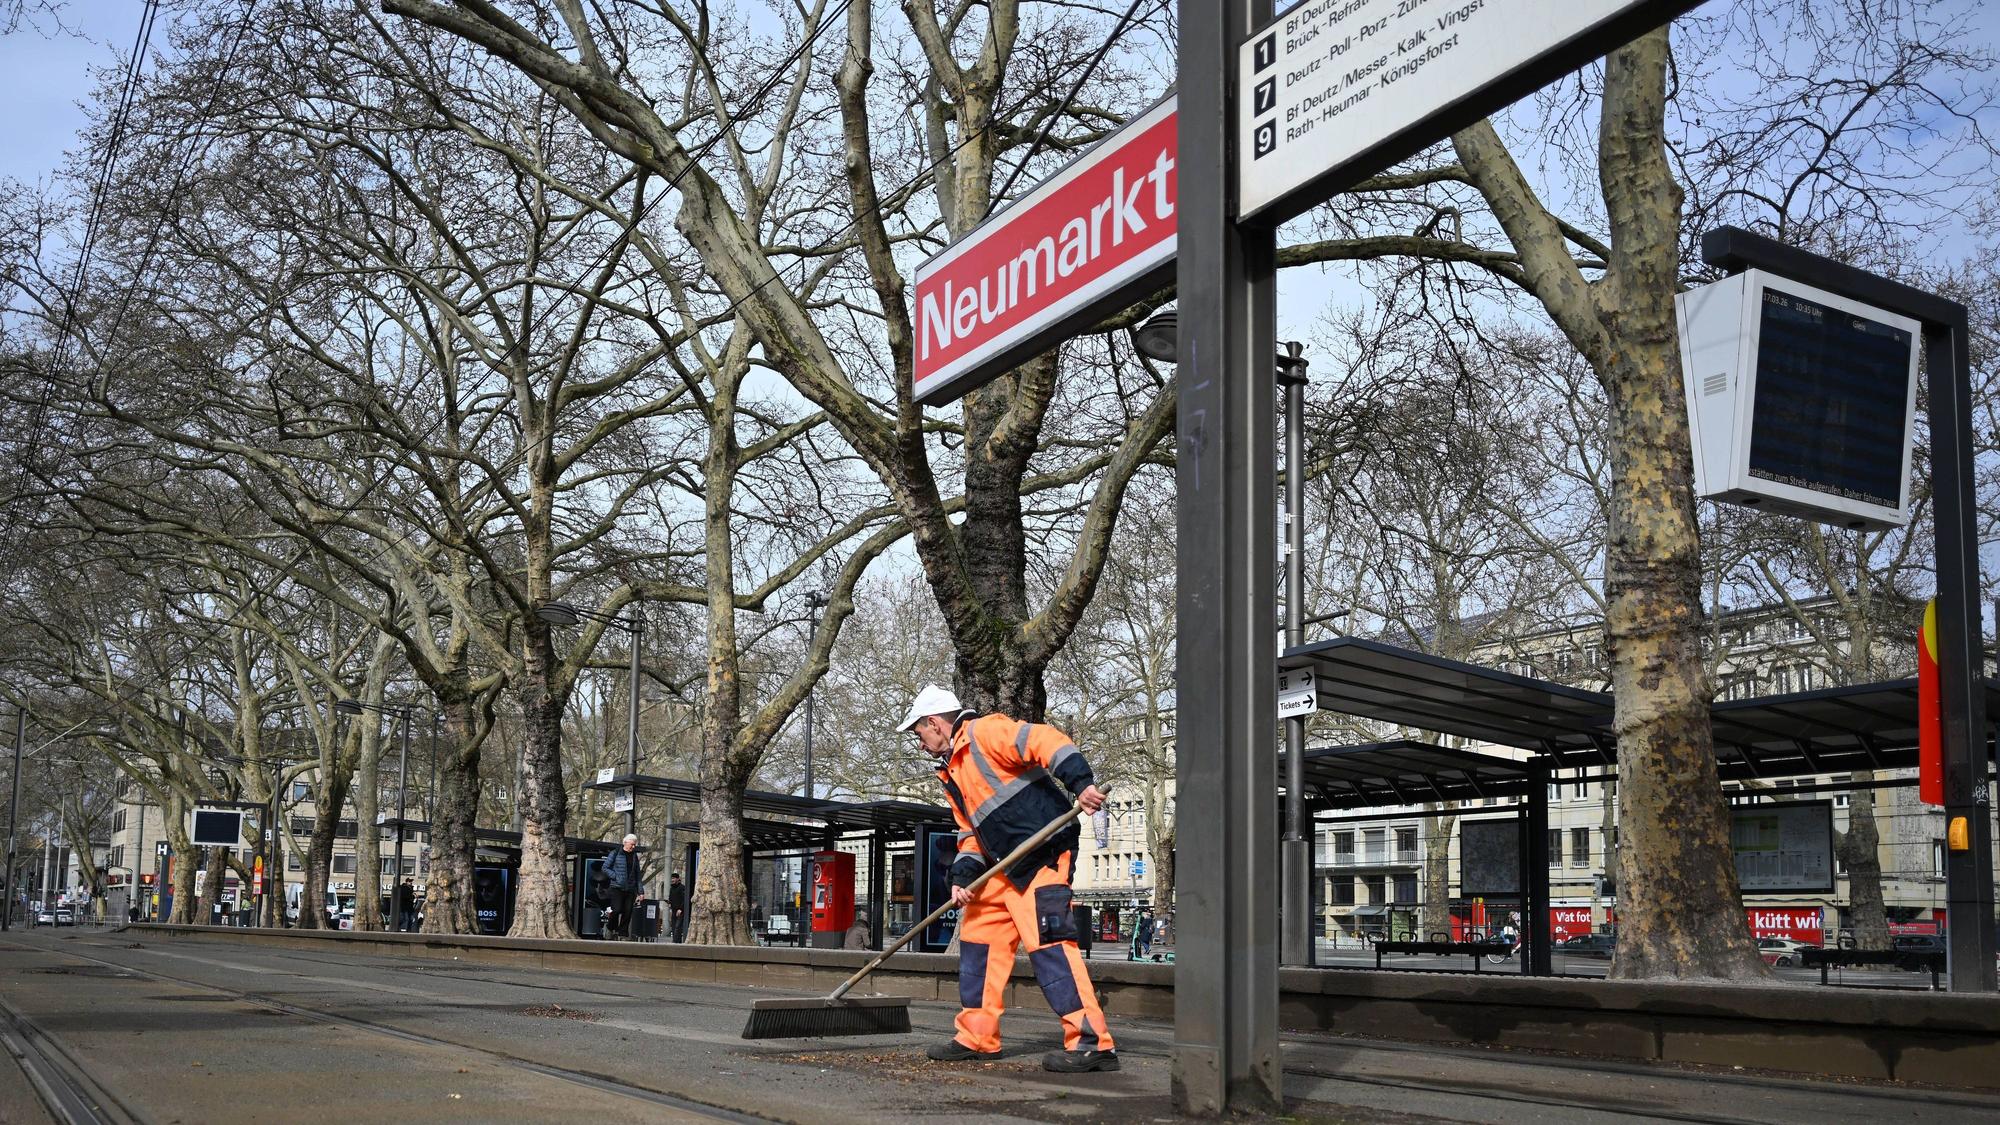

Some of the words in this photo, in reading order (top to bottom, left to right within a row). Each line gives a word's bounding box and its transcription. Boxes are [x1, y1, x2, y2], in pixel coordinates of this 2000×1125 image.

[1286, 16, 1299, 35] Bf
[1259, 40, 1269, 65] 1
[1258, 82, 1271, 110] 7
[1286, 104, 1300, 123] Bf
[1258, 126, 1272, 153] 9
[921, 147, 1175, 361] Neumarkt
[1812, 306, 1823, 318] Uhr
[1774, 473, 1789, 484] zum
[1789, 475, 1807, 489] Streik
[1808, 481, 1842, 496] aufgerufen.
[1844, 488, 1862, 501] Daher
[1862, 491, 1882, 504] fahren
[1280, 701, 1301, 710] Tickets
[157, 844, 168, 856] H
[1755, 912, 1791, 929] kütt
